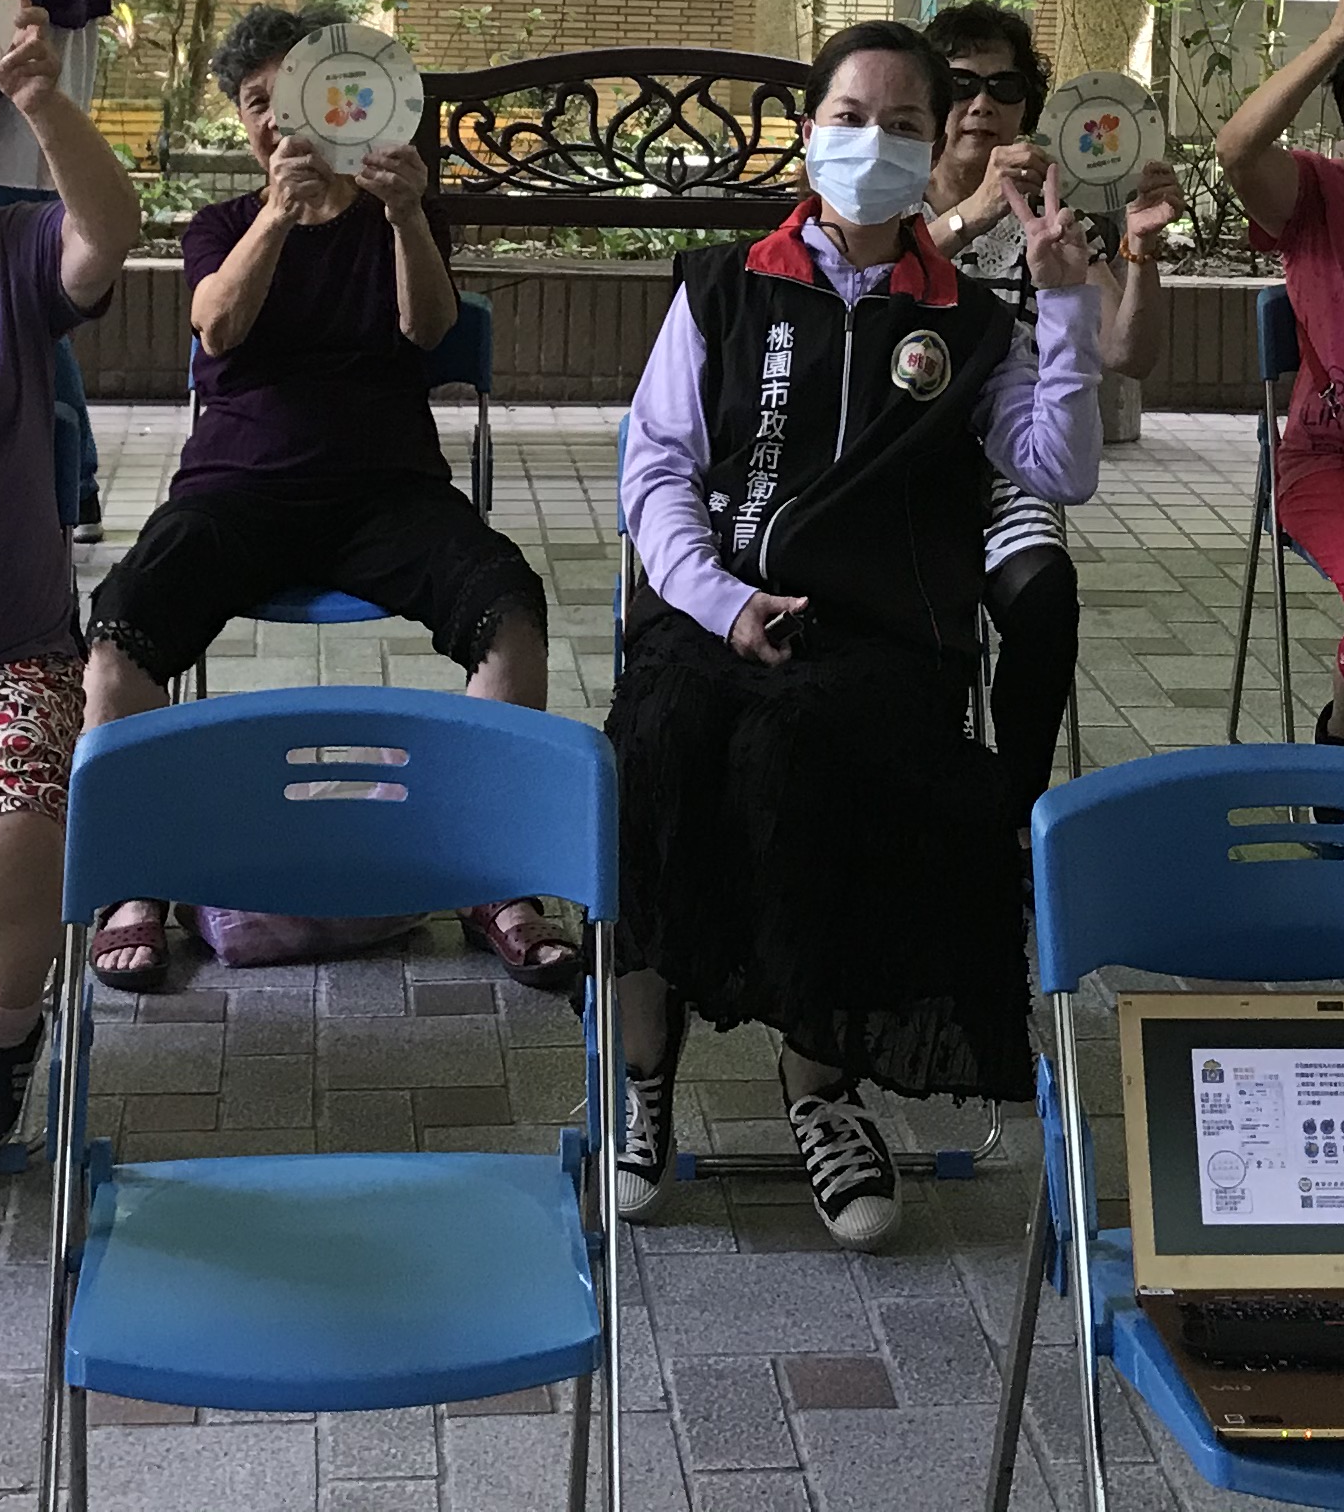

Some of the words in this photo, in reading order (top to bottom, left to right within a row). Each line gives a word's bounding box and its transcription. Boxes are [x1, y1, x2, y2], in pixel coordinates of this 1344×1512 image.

[732, 322, 795, 554] 桃園市政府衛生局
